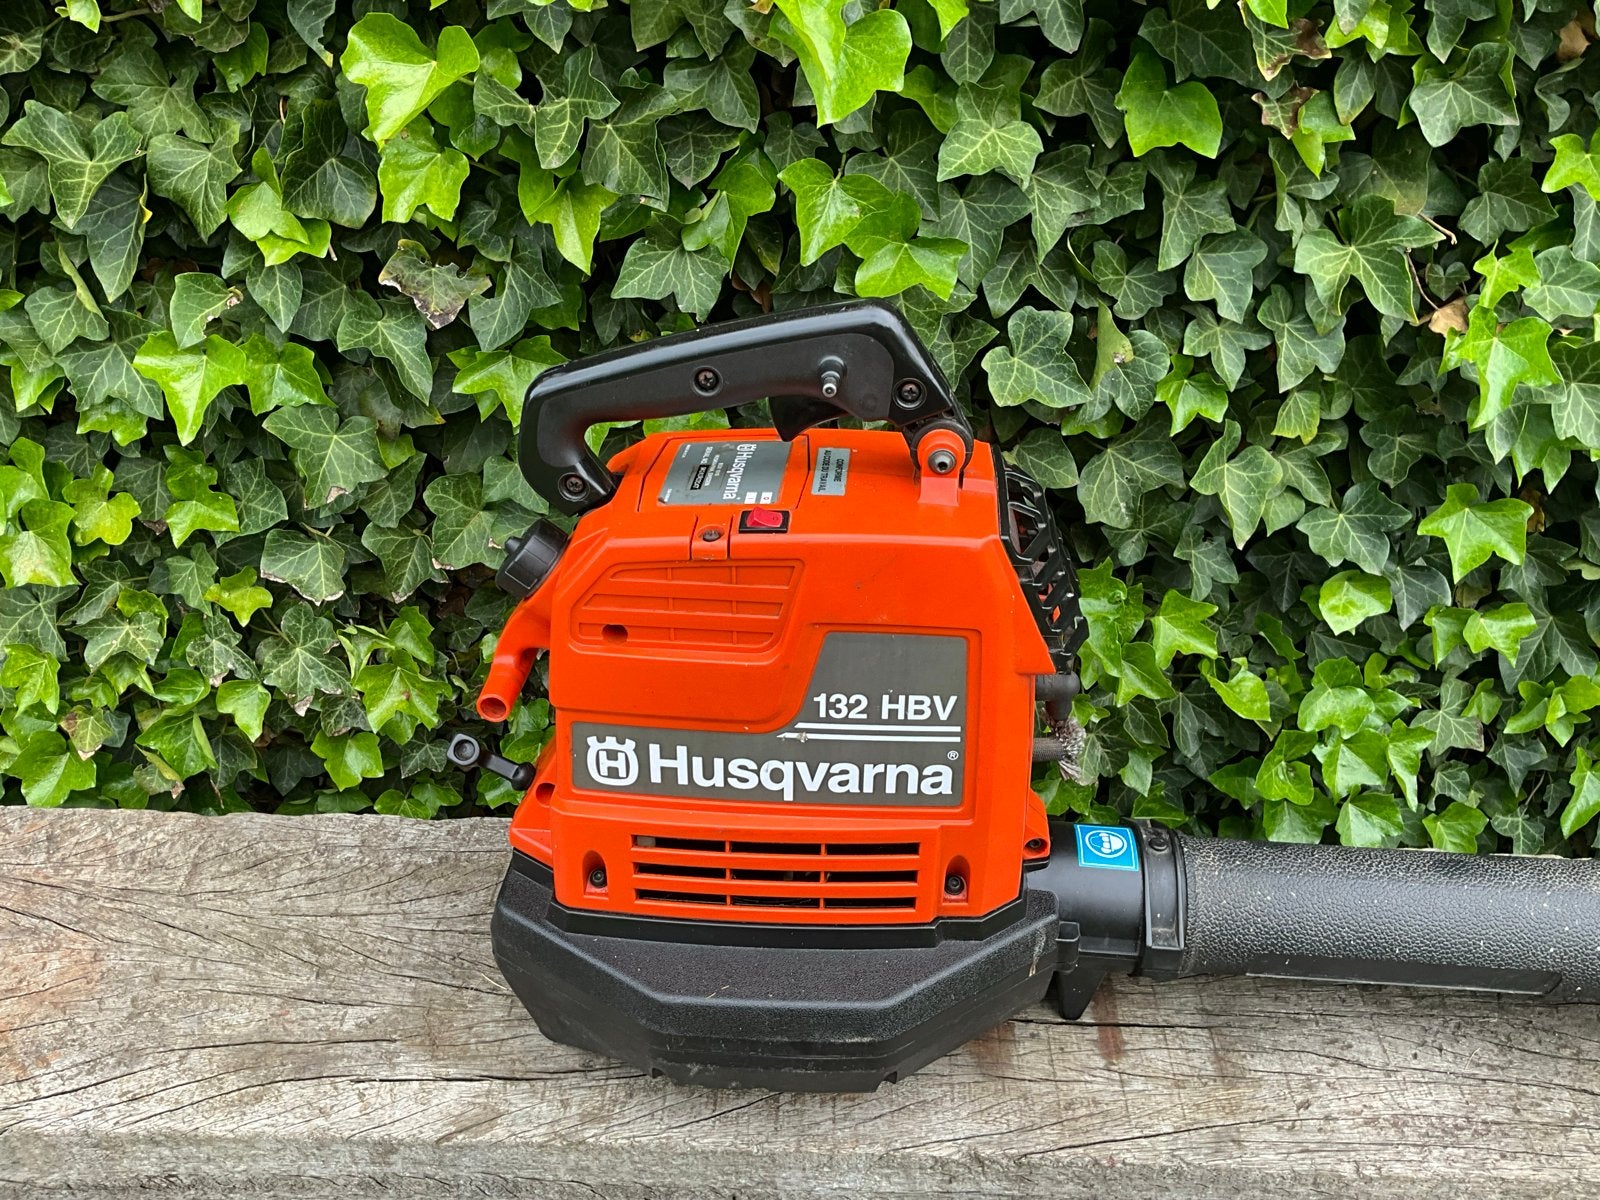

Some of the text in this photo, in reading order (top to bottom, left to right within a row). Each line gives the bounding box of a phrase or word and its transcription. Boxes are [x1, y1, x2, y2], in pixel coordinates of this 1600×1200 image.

[723, 452, 752, 500] Husqvarna
[813, 692, 958, 721] 132 HBV
[648, 743, 954, 801] Husqvarna
